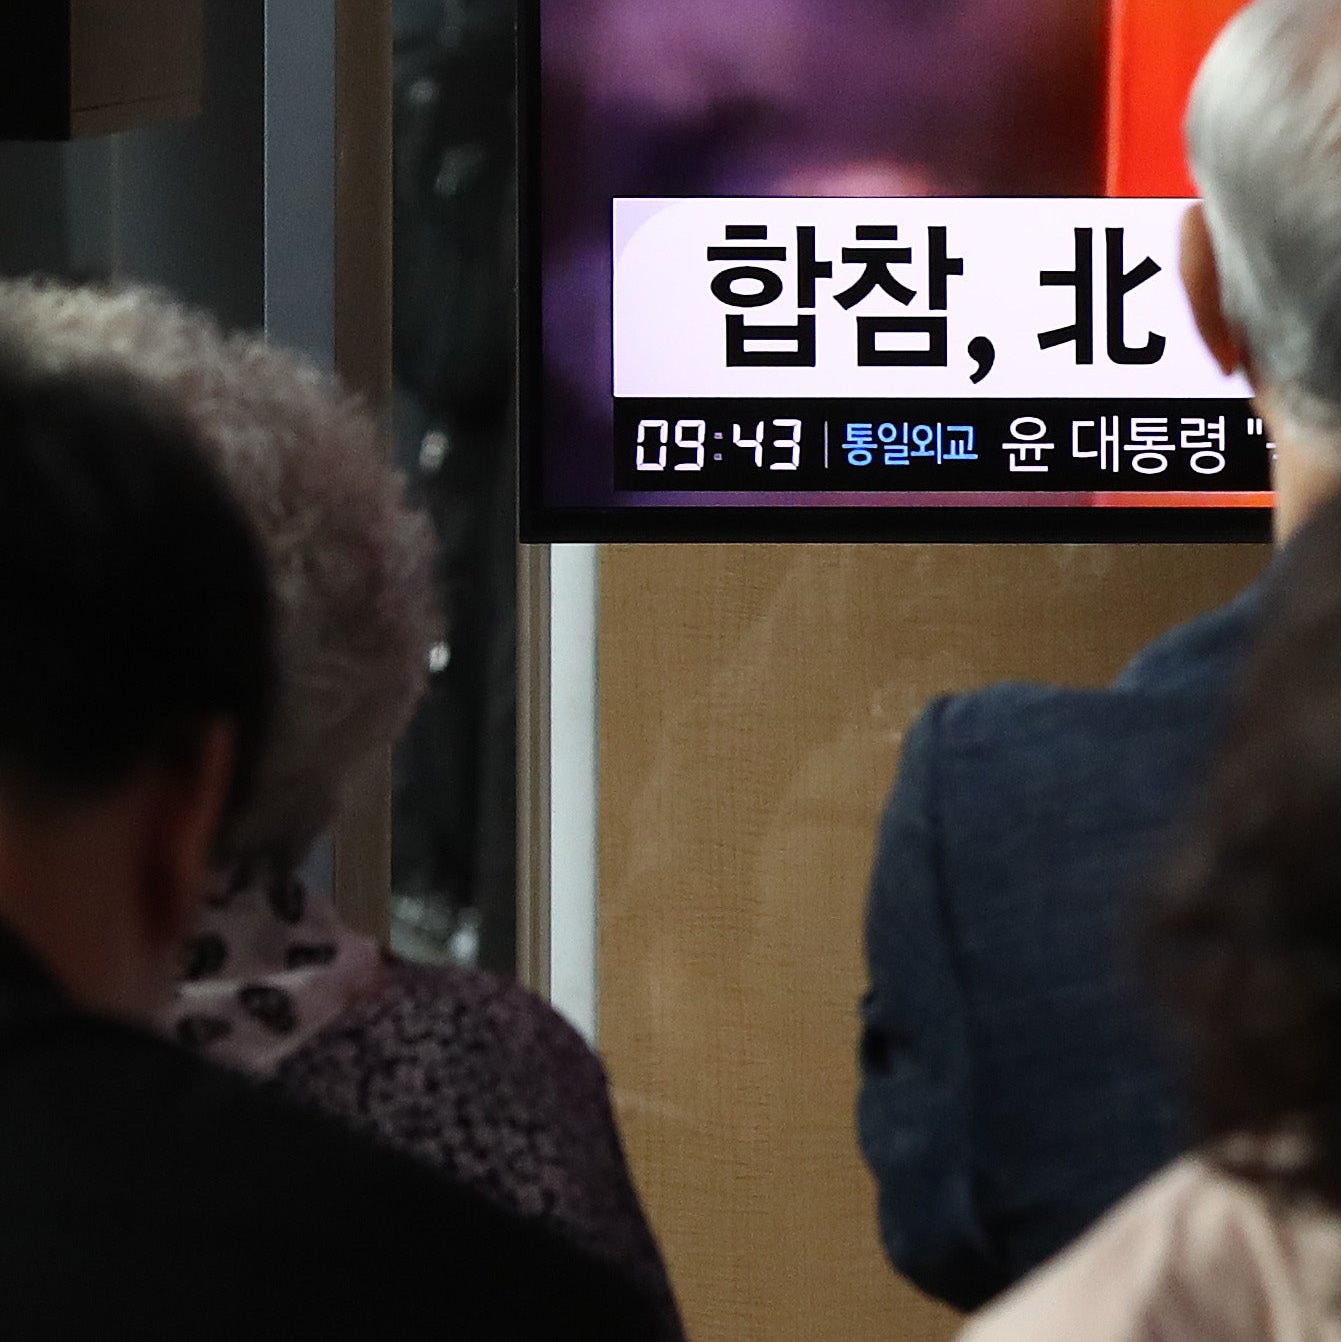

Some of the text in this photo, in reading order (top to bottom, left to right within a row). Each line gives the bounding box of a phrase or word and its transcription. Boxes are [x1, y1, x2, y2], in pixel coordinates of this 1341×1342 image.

[706, 224, 996, 385] 합참,
[1037, 227, 1167, 365] 北
[636, 418, 802, 471] 09:43
[841, 422, 979, 466] 통일외교
[1001, 416, 1055, 472] 윤
[1072, 415, 1226, 475] 대통령
